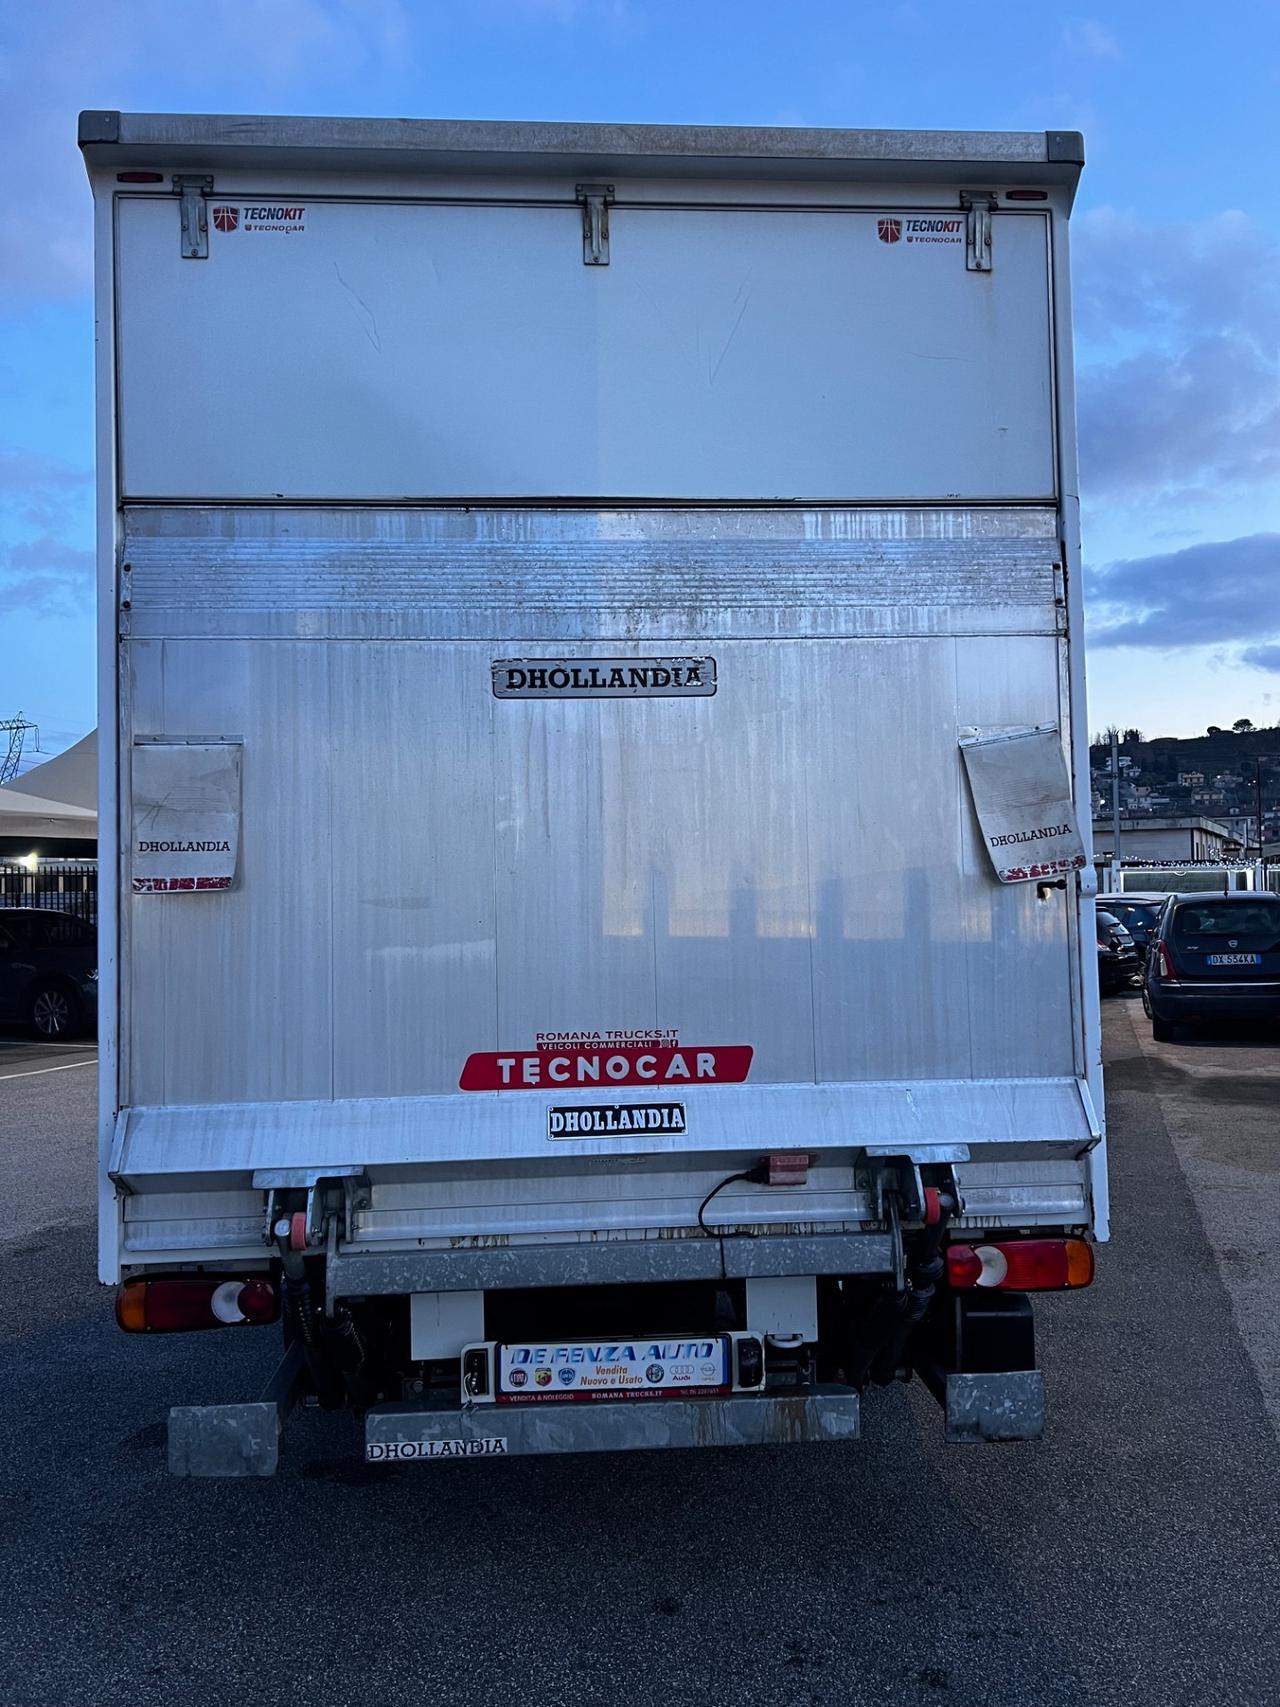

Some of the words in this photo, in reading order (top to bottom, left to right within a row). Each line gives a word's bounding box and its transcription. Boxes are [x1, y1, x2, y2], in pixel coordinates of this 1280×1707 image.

[243, 207, 305, 221] TECNOKIT
[905, 220, 963, 233] TECNOKIT
[915, 236, 962, 244] TECNOCAR
[505, 667, 705, 690] DHOLLANDIA
[989, 823, 1073, 848] DHOLLANDIA
[138, 841, 231, 852] DHOLLANDIA
[536, 1031, 601, 1041] ROMANA
[605, 1029, 679, 1040] TRUCKS.IT
[584, 1041, 652, 1049] COMMERCIALI
[497, 1052, 716, 1084] TECNOCAR
[550, 1107, 685, 1132] DHOLLANDIA
[511, 1348, 547, 1364] DE
[641, 1343, 714, 1361] AUTO
[596, 1365, 628, 1375] Vendita
[580, 1376, 608, 1386] Nuovo
[618, 1375, 643, 1384] Usato
[592, 1391, 624, 1400] ROMANA
[368, 1438, 506, 1460] DHOLLANDIA
